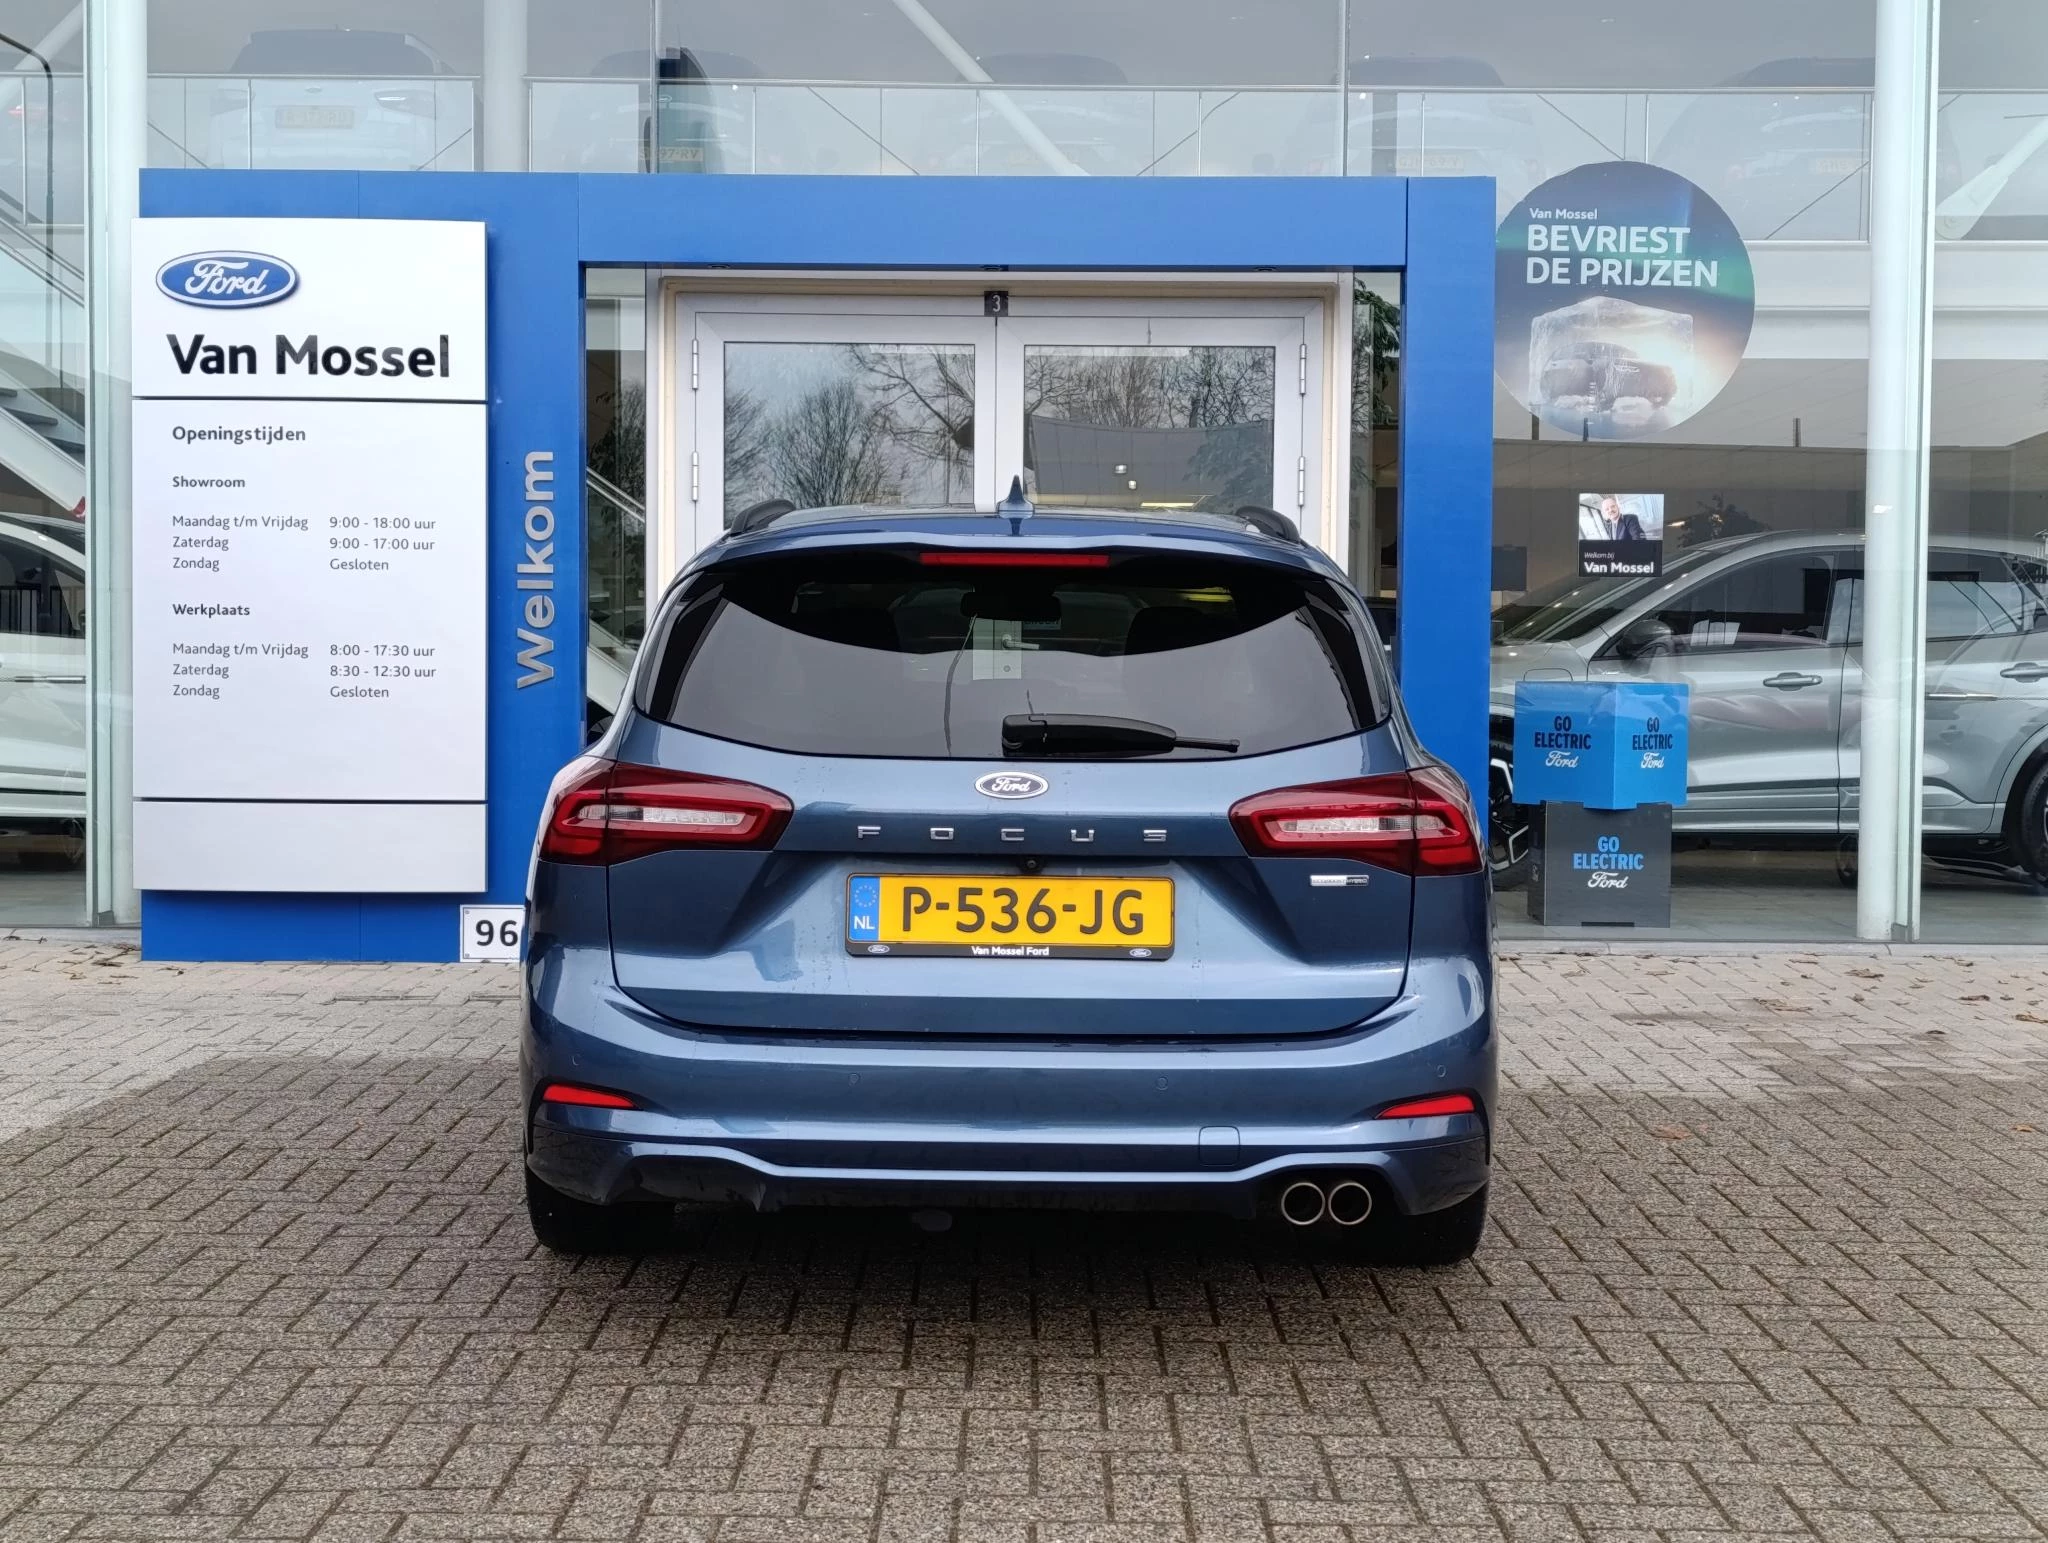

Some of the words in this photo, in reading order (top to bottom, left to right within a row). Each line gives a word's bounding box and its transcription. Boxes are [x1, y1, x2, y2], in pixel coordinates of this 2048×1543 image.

[1529, 207, 1552, 219] Van
[1555, 208, 1598, 220] Mossel
[1527, 224, 1691, 254] BEVRIEST
[185, 259, 269, 295] Ford
[1526, 257, 1571, 284] DE
[1580, 258, 1718, 287] PRIJZEN
[992, 294, 1001, 312] 3
[166, 334, 257, 375] Van
[275, 334, 450, 378] Mossel
[172, 425, 306, 446] Openingstijden
[172, 475, 246, 488] Showroom
[172, 514, 231, 531] Maandag
[233, 514, 258, 528] t/m
[261, 515, 309, 532] Vrijdag
[329, 516, 360, 529] 9:00
[372, 517, 411, 529] 18:00
[414, 520, 436, 530] uur
[172, 535, 230, 552] Zaterdag
[329, 537, 360, 550] 9:00
[373, 537, 410, 550] 17:00
[413, 541, 435, 551] uur
[172, 556, 220, 573] Zondag
[329, 557, 389, 571] Gesloten
[517, 451, 554, 689] Welkom
[1583, 562, 1608, 573] Van
[1610, 562, 1654, 574] Mossel
[172, 603, 251, 619] Werkplaats
[172, 642, 231, 659] Maandag
[233, 643, 258, 656] t/m
[261, 643, 309, 660] Vrijdag
[330, 643, 361, 657] 8:00
[373, 644, 410, 657] 17:30
[413, 648, 436, 657] uur
[172, 663, 230, 680] Zaterdag
[330, 664, 360, 677] 8:30
[373, 665, 411, 678] 12:30
[414, 668, 437, 678] uur
[172, 684, 220, 700] Zondag
[329, 685, 390, 698] Gesloten
[1554, 716, 1572, 732] GO
[1646, 717, 1660, 733] GO
[1534, 732, 1592, 750] ELECTRIC
[1632, 734, 1673, 751] ELECTRIC
[1545, 750, 1579, 768] Ford
[1640, 752, 1665, 769] Ford
[991, 776, 1031, 792] Ford
[857, 825, 1167, 843] FOCUS
[1597, 836, 1620, 853] GO
[1573, 852, 1645, 870] ELECTRIC
[1587, 871, 1629, 889] Ford
[902, 886, 1144, 935] P-536-JG
[853, 915, 876, 931] NL
[475, 919, 519, 947] 96
[971, 945, 989, 956] Van
[991, 946, 1024, 957] Mossel
[1026, 947, 1050, 957] Ford
